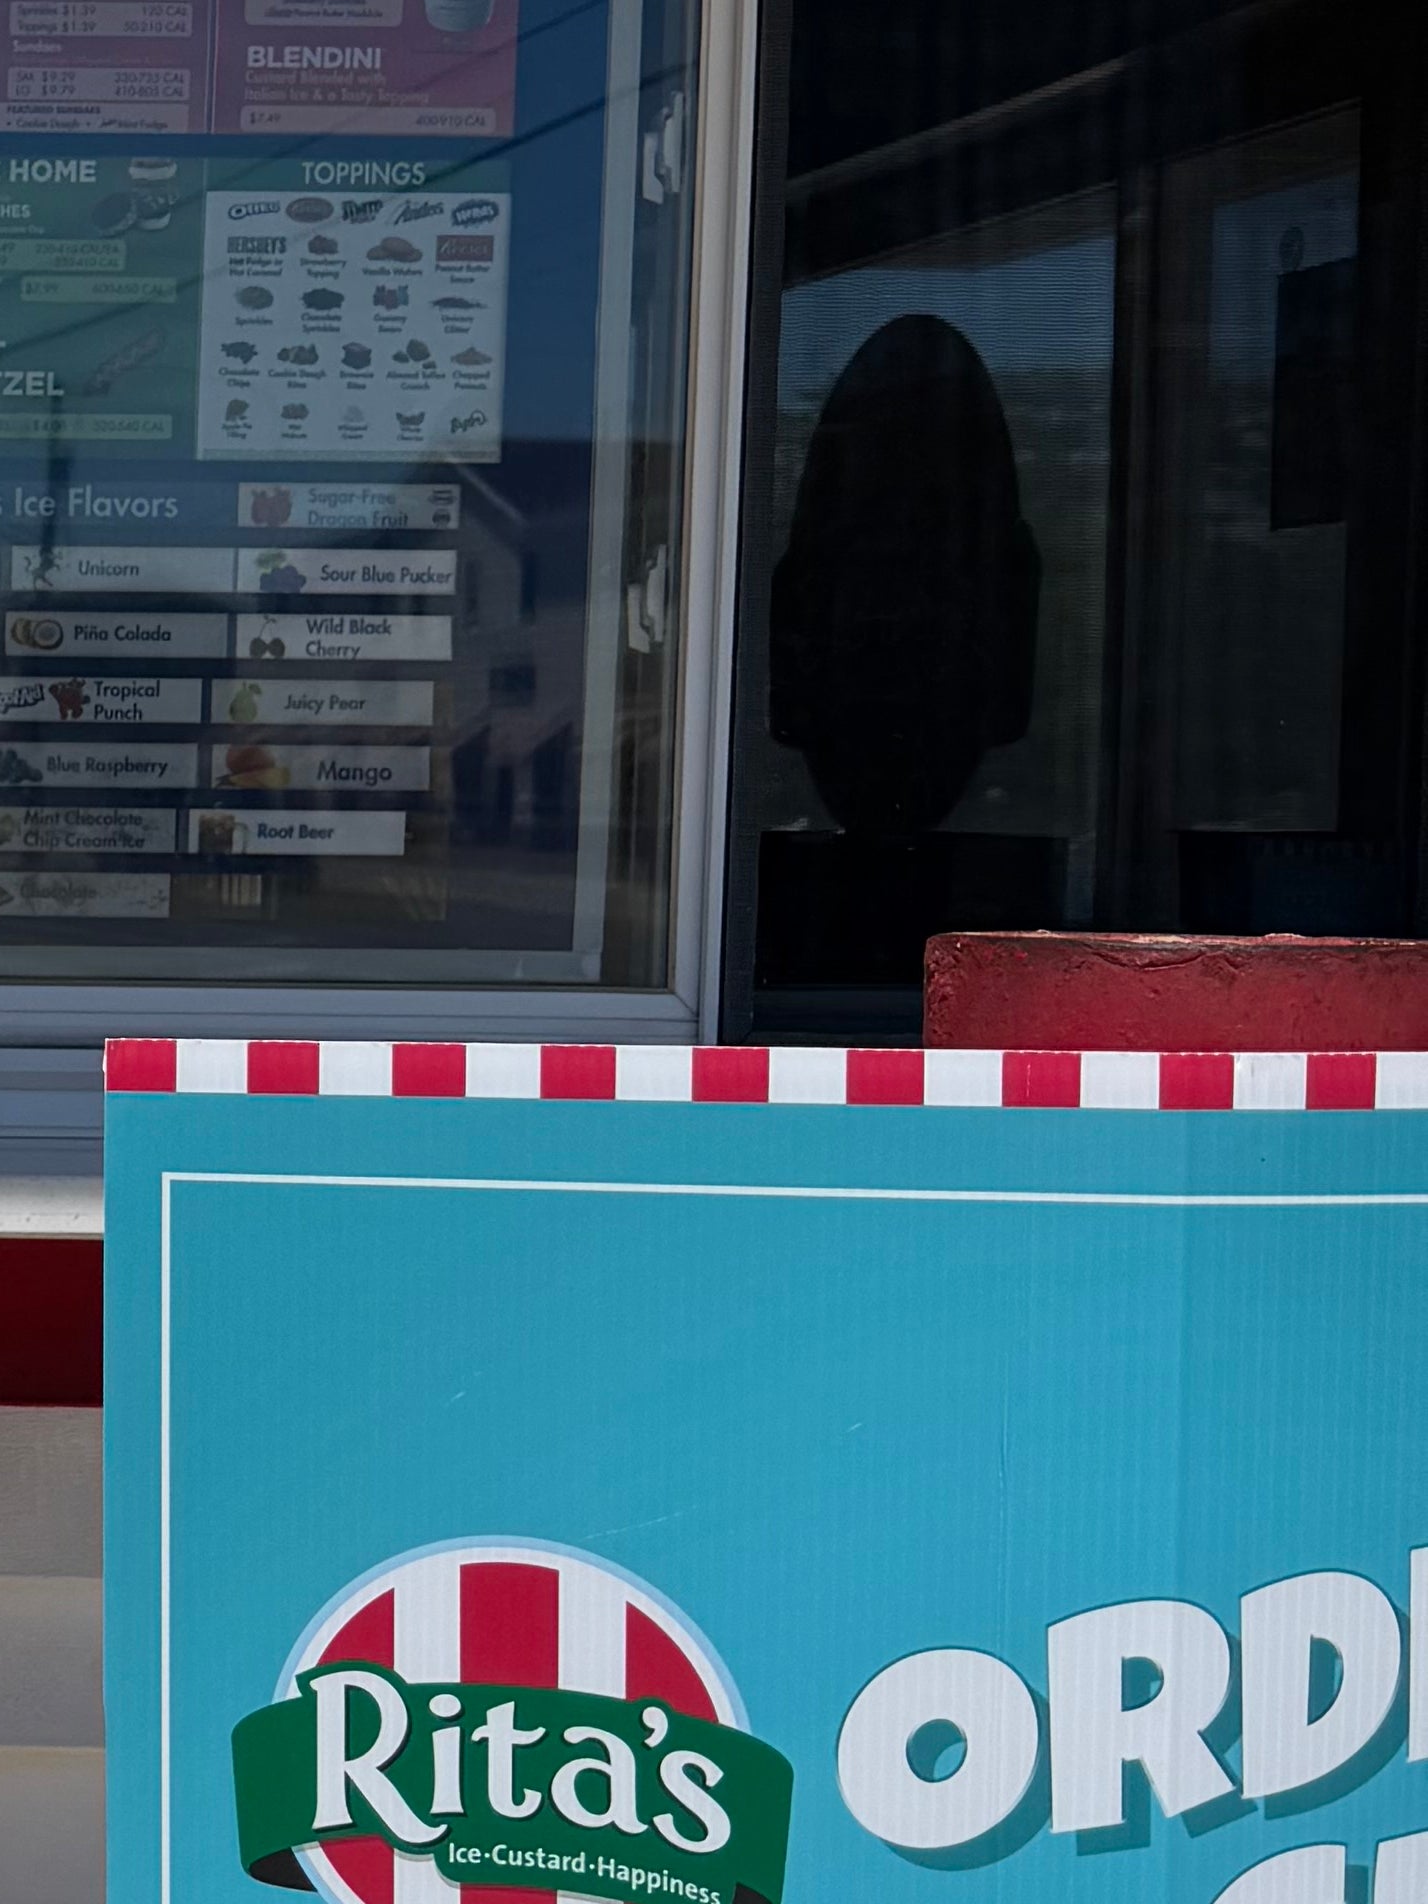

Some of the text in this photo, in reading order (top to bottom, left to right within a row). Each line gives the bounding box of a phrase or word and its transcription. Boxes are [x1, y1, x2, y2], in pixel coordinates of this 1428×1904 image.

[247, 46, 382, 69] BLENDINI
[9, 159, 96, 184] HOME
[302, 161, 427, 185] TOPPINGS
[14, 485, 55, 516] Ice
[68, 484, 178, 518] Flavors
[373, 512, 409, 526] Fruit
[78, 560, 139, 577] Unicorn
[321, 566, 452, 584] Sour Blue Pucker
[74, 625, 172, 642] Piña Colada
[306, 619, 392, 636] Wild Black
[305, 641, 361, 660] Cherry
[93, 680, 161, 702] Tropical
[94, 704, 143, 721] Punch
[283, 695, 366, 714] Juicy Pear
[47, 757, 169, 778] Blue Raspberry
[317, 761, 393, 785] Mango
[257, 824, 335, 840] Root Beer
[837, 1548, 1428, 1850] ORD
[310, 1670, 732, 1855] Rita's
